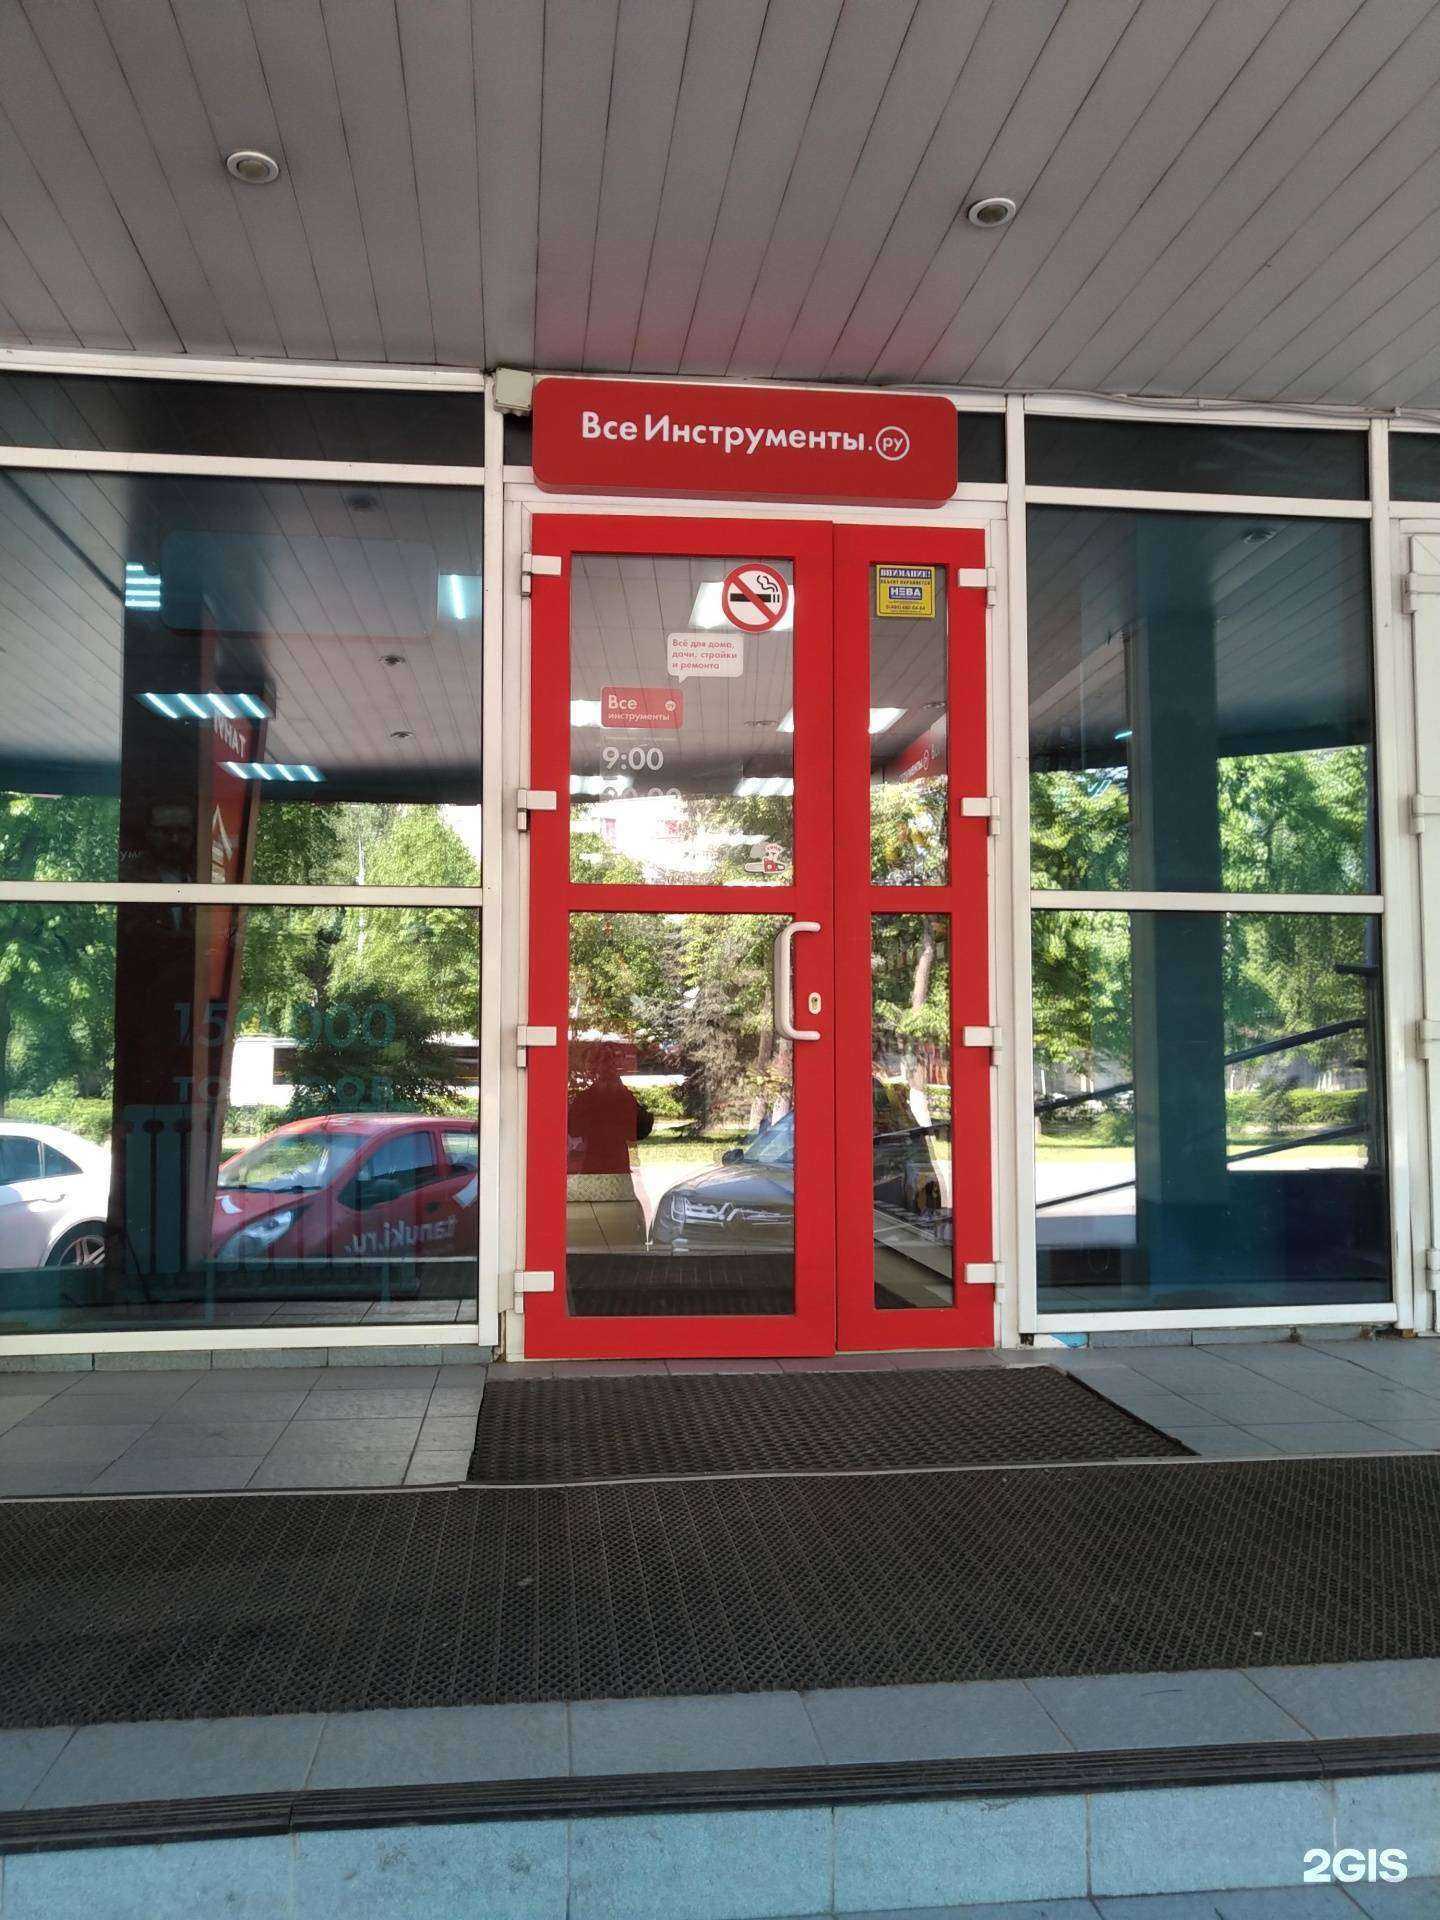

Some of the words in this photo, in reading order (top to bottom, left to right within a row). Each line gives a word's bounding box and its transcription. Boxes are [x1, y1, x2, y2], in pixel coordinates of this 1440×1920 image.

[582, 410, 638, 440] Все
[644, 413, 873, 455] Инструменты.
[890, 587, 921, 597] НЕВА
[690, 641, 706, 649] для
[700, 651, 738, 661] стройки
[680, 662, 720, 671] ремонта
[608, 694, 638, 710] Все
[608, 712, 670, 722] инструменты
[602, 746, 664, 771] 9:00
